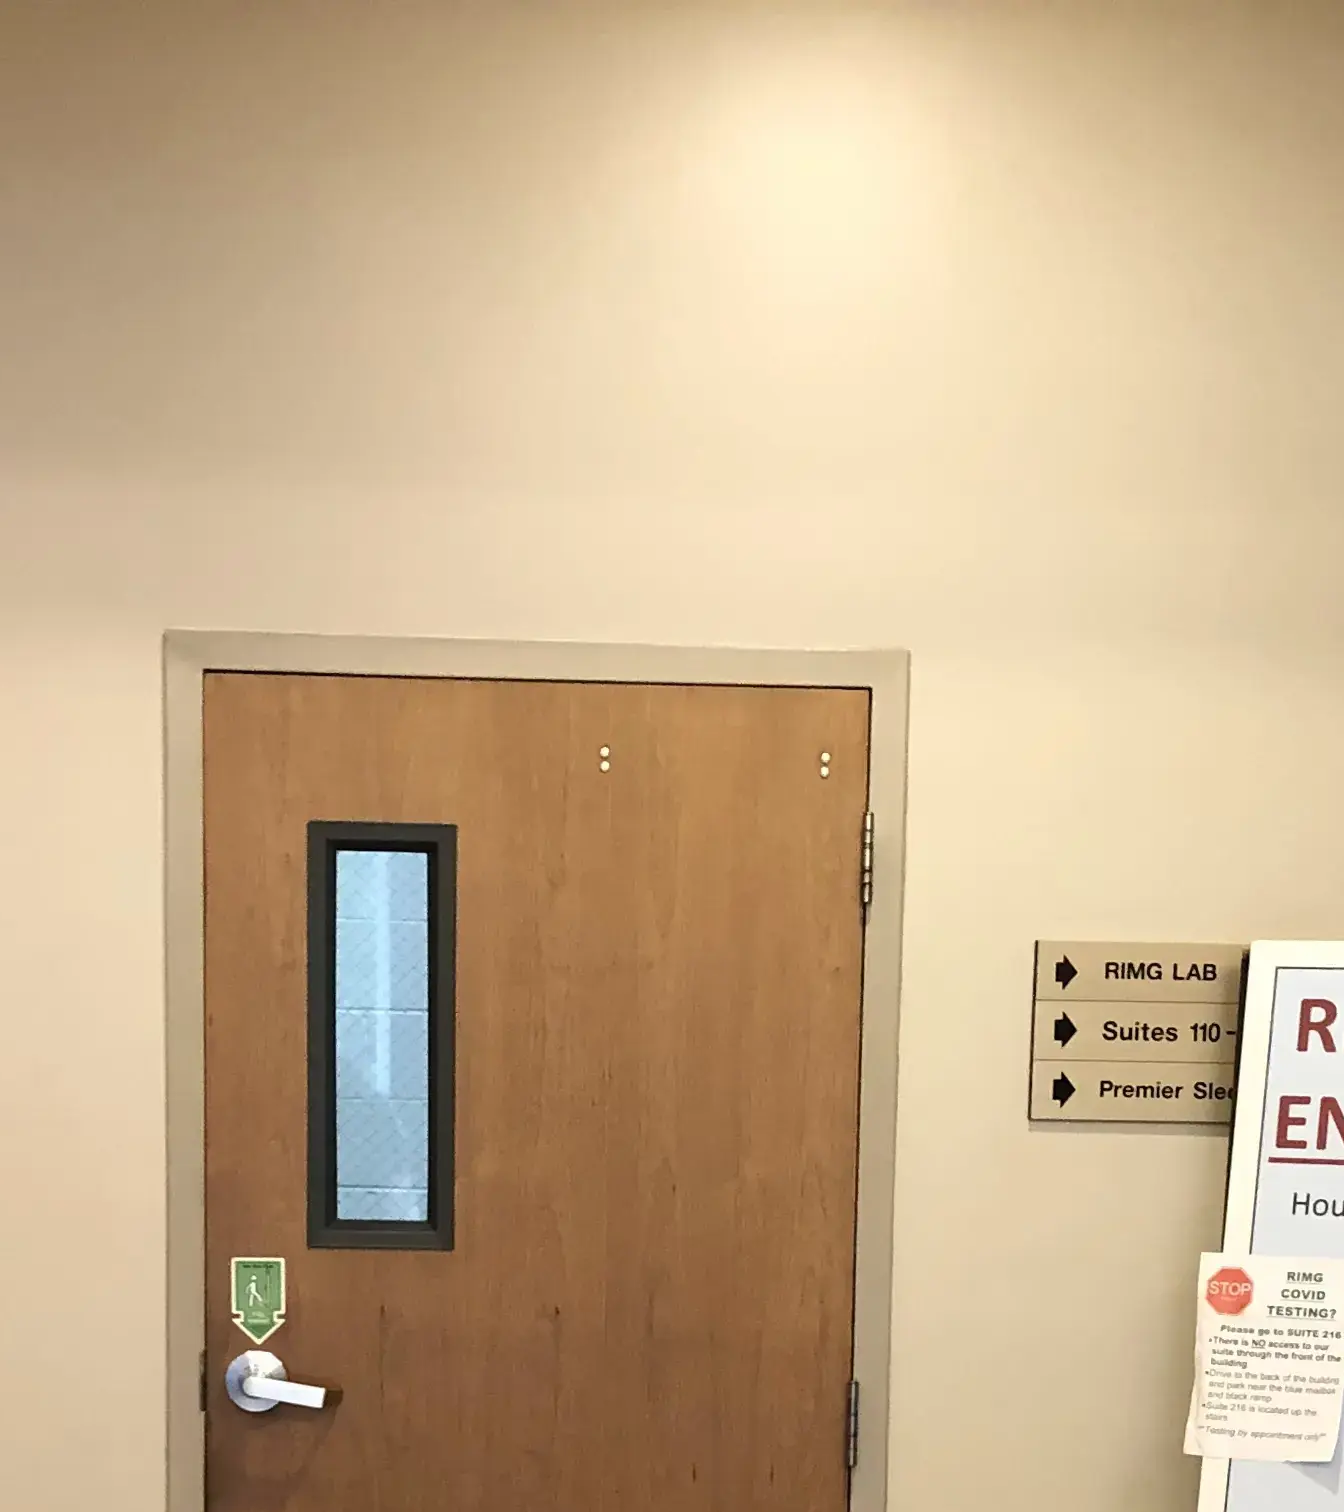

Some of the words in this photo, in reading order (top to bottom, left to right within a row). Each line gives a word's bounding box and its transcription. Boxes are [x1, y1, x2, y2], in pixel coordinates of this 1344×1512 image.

[1104, 962, 1163, 981] RIMG
[1172, 963, 1217, 981] LAB
[1102, 1020, 1179, 1042] Suites
[1099, 1080, 1183, 1100] Premier
[1286, 1271, 1324, 1283] RIMG
[1208, 1280, 1252, 1296] STOP
[1280, 1288, 1326, 1300] COVID
[1266, 1305, 1337, 1319] TESTING?
[1220, 1324, 1255, 1334] Please
[1258, 1328, 1270, 1336] go
[1274, 1328, 1284, 1336] to
[1287, 1328, 1319, 1338] SUITE
[1322, 1331, 1342, 1339] 216
[1241, 1338, 1249, 1346] is
[1251, 1339, 1266, 1347] NO
[1302, 1342, 1311, 1350] to
[1210, 1357, 1248, 1369] building
[1274, 1351, 1289, 1359] the
[1315, 1353, 1325, 1361] of
[1327, 1354, 1342, 1362] the
